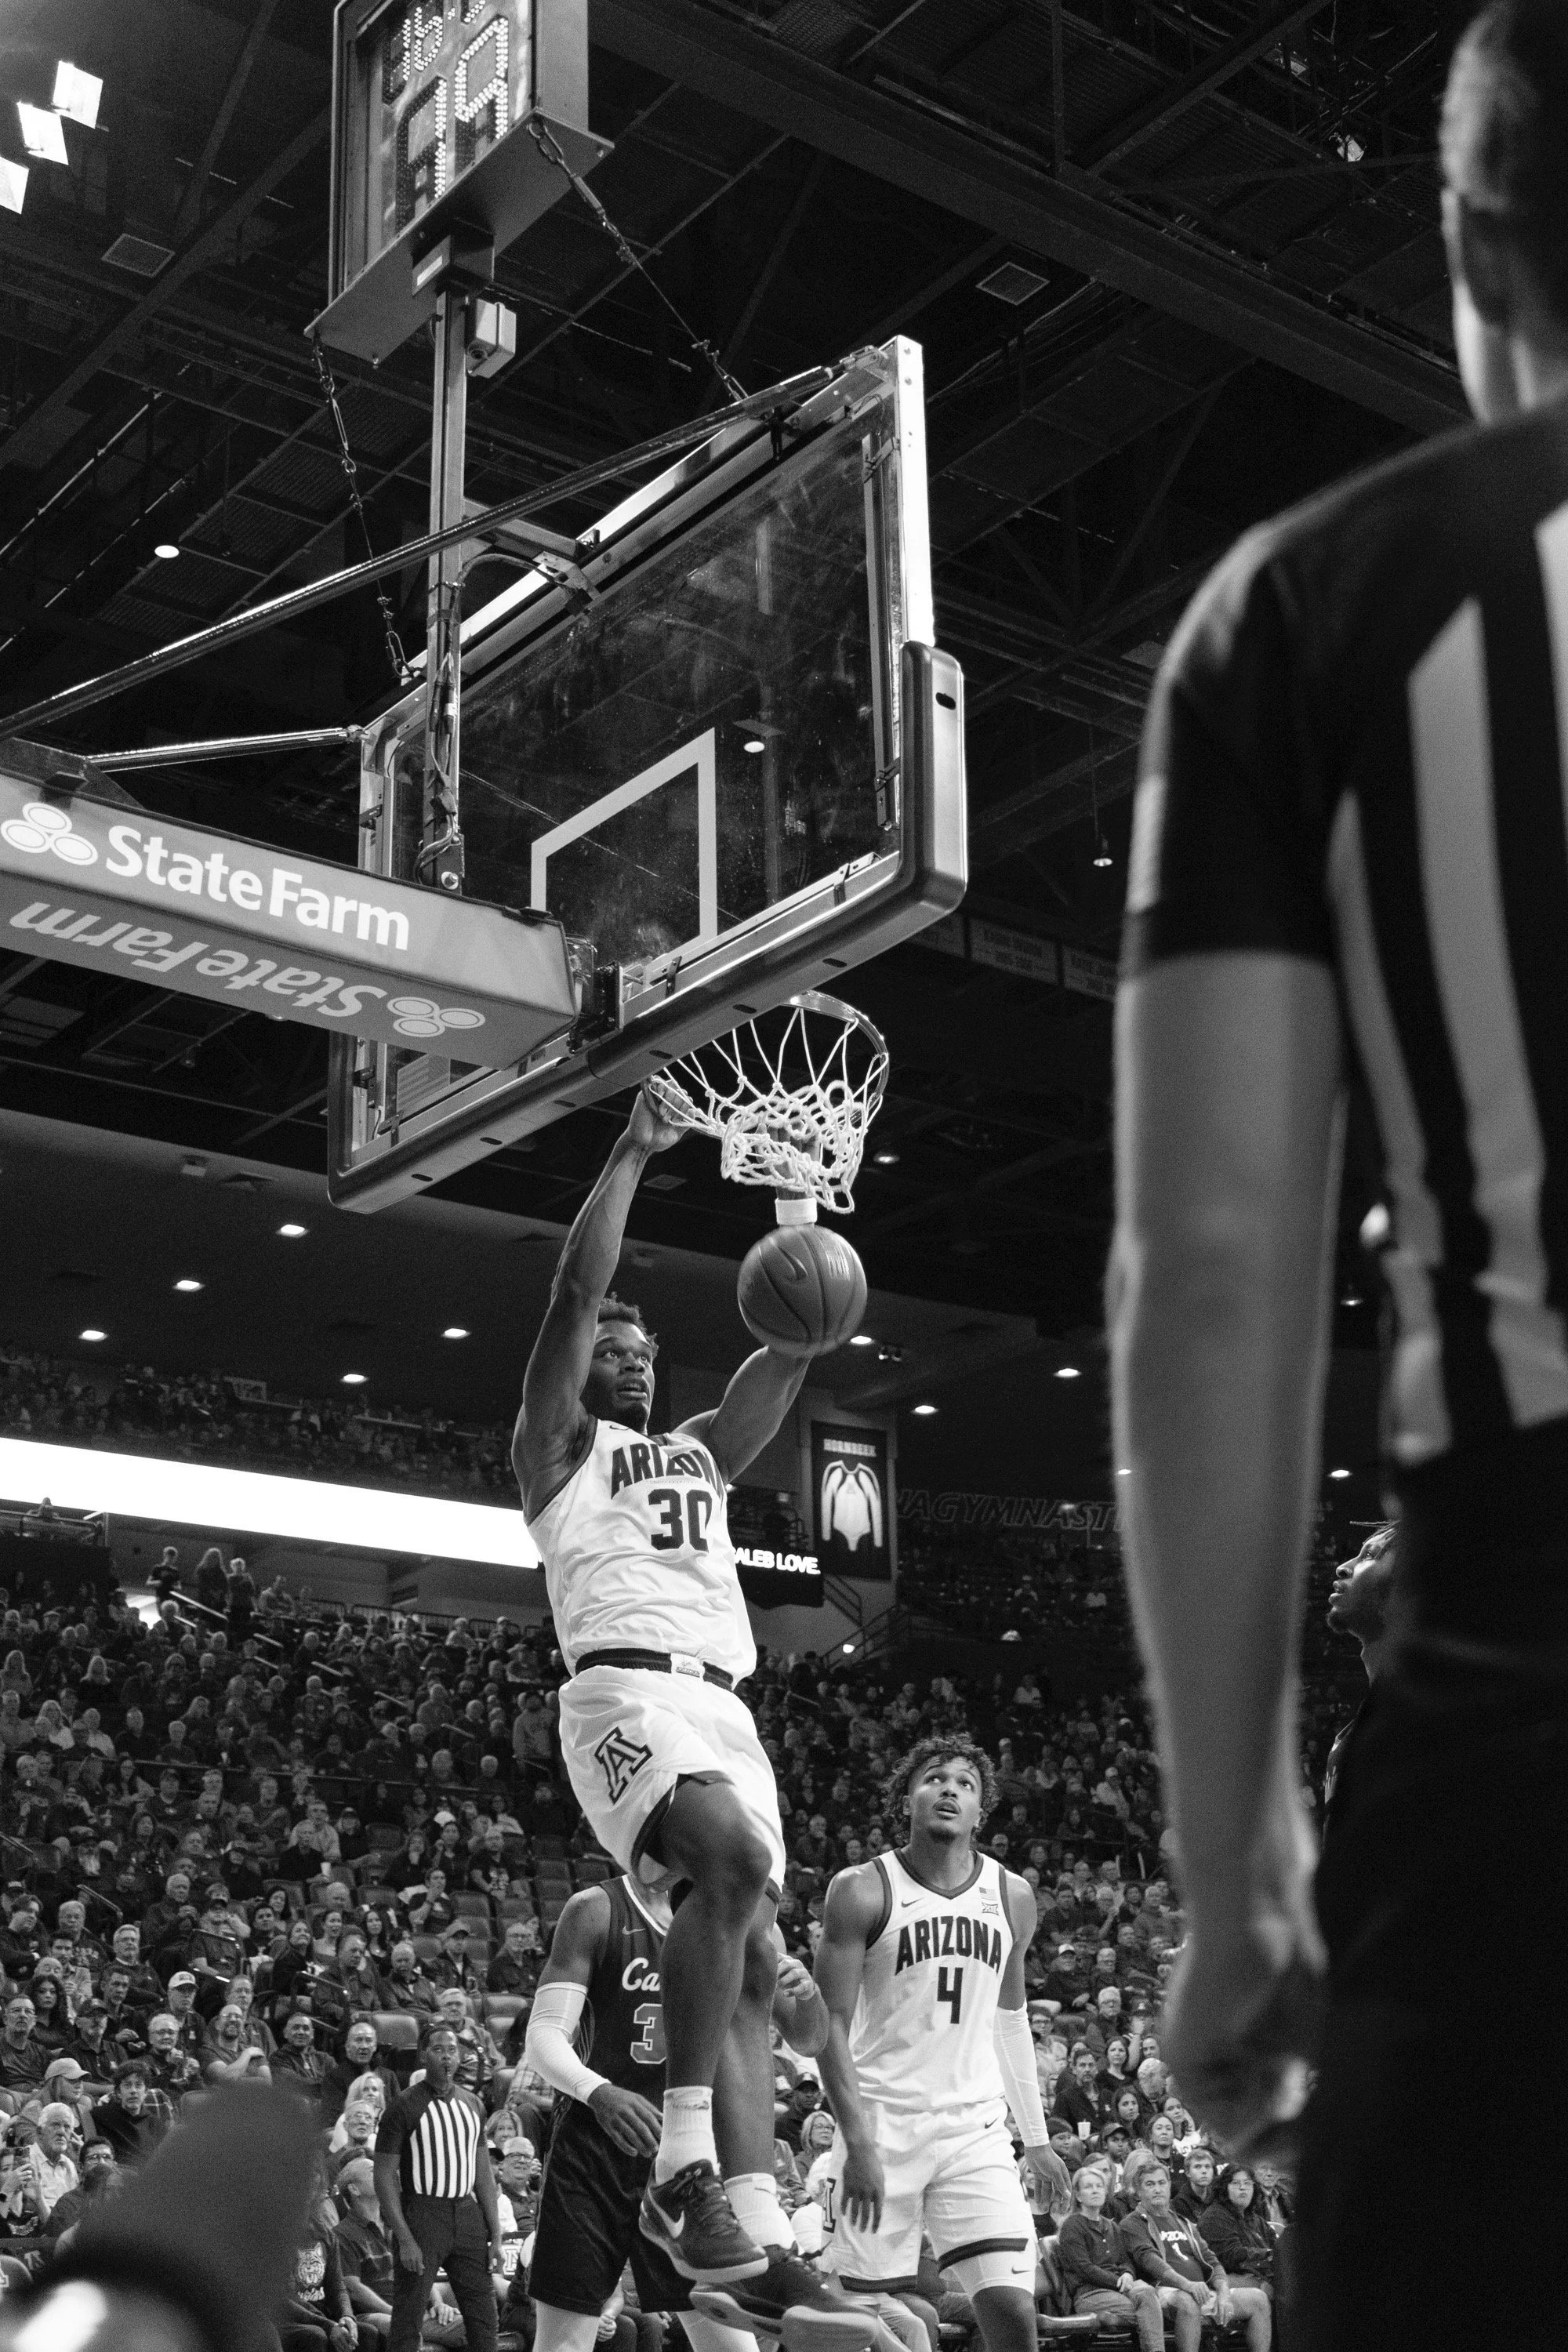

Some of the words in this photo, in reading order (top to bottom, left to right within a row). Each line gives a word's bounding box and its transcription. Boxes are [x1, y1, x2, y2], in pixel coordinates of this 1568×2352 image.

[648, 1488, 713, 1555] 30
[735, 1547, 775, 1568] ALEB
[622, 1957, 661, 1991] Ca
[895, 1915, 1002, 1977] ARIZONA
[937, 1966, 964, 2024] 4
